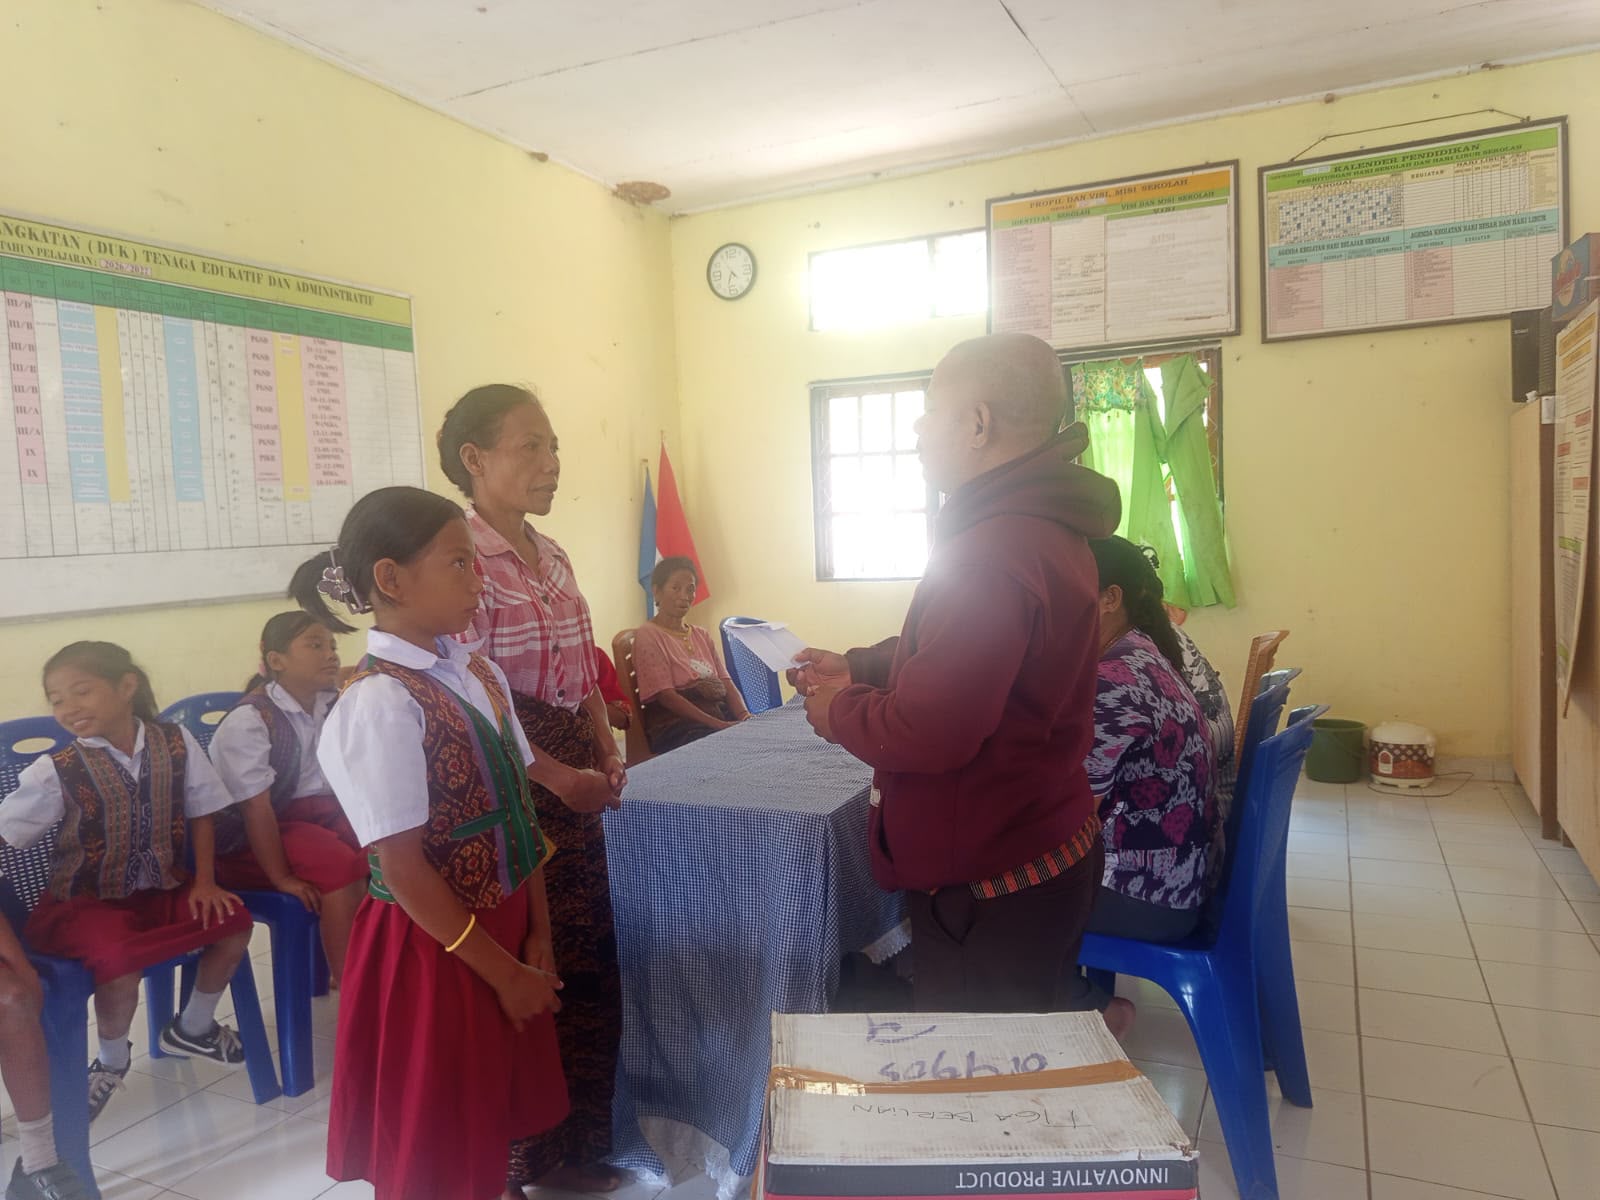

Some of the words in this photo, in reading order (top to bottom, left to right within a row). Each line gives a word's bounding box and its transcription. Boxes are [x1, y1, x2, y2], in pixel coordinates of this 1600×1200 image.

[1334, 158, 1398, 172] KALENDER
[1402, 144, 1480, 161] PENDIDIKAN
[1141, 179, 1188, 192] SEKOLAH
[1178, 191, 1215, 201] SEKOLAH
[0, 241, 34, 255] TAHUN
[0, 222, 80, 250] NGKATAN
[143, 249, 197, 273] TENAGA
[202, 261, 263, 284] EDUKATIF
[269, 275, 290, 289] DAN
[995, 1108, 1093, 1130] TIGA
[955, 1169, 1046, 1190] PRODUCT
[1052, 1166, 1169, 1187] INNOVATIVE
